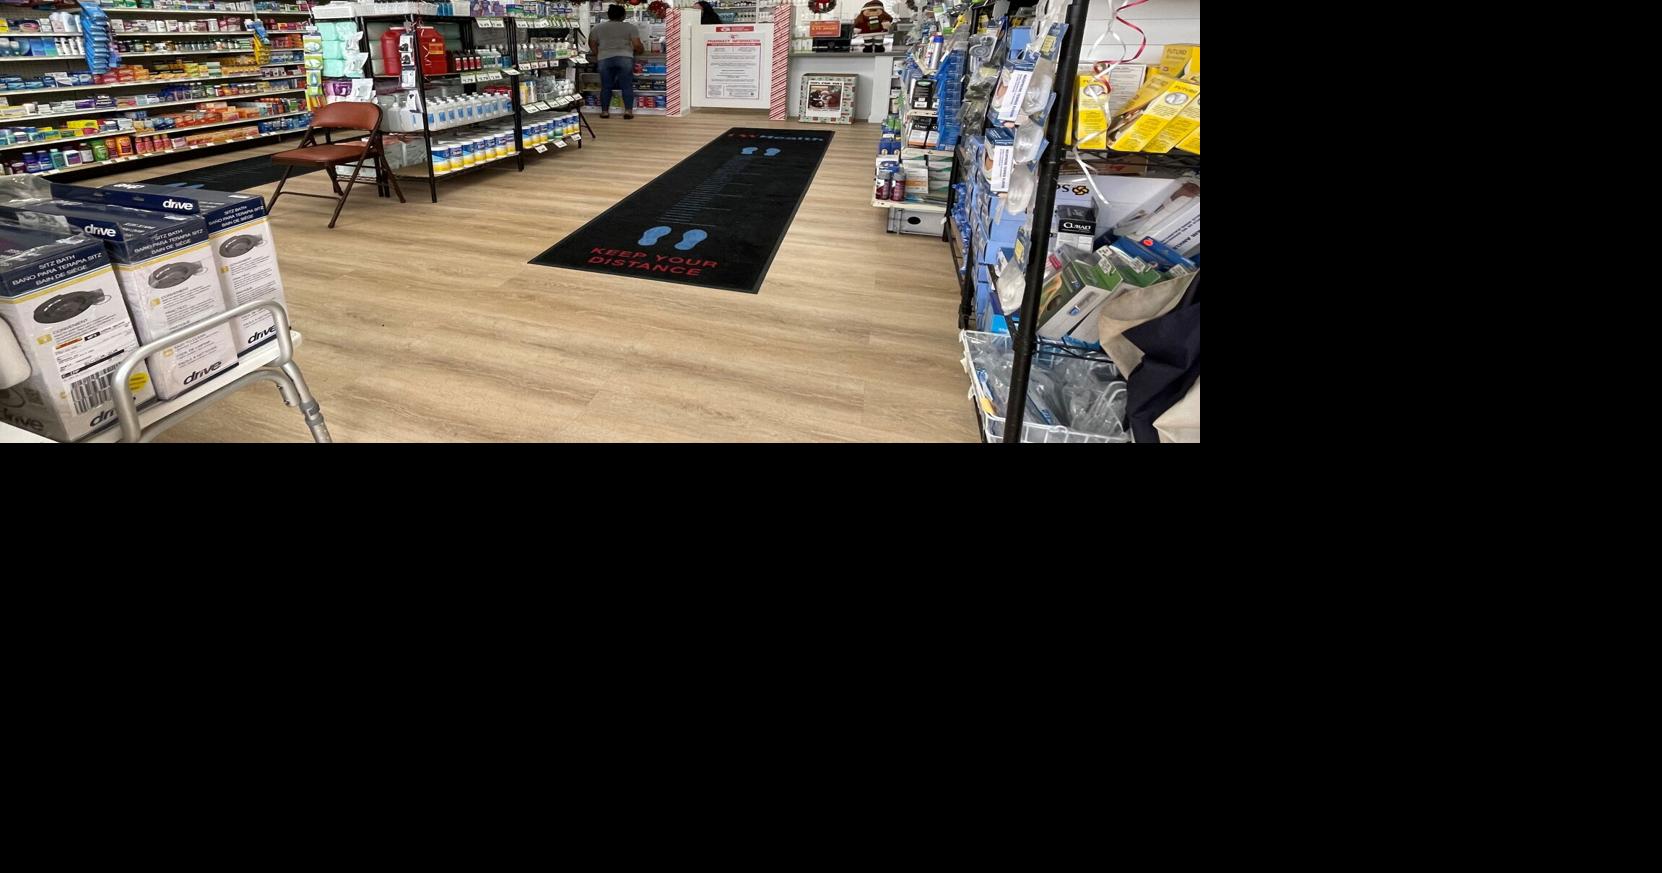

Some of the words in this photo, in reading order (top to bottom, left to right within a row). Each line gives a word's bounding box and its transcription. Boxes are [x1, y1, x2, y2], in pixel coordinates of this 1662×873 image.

[162, 199, 194, 211] drive
[84, 224, 116, 237] drive
[37, 268, 57, 278] PARA
[59, 259, 87, 272] TERAPIA
[87, 252, 102, 261] SITZ
[39, 260, 56, 270] SITZ
[55, 254, 76, 266] BATH
[588, 256, 702, 276] DISTANCE
[591, 247, 648, 258] KEEP
[655, 254, 719, 268] YOUR
[35, 276, 54, 286] BAIN
[55, 271, 65, 280] DE
[247, 325, 276, 344] drive
[183, 361, 222, 385] drive
[90, 408, 115, 427] dri
